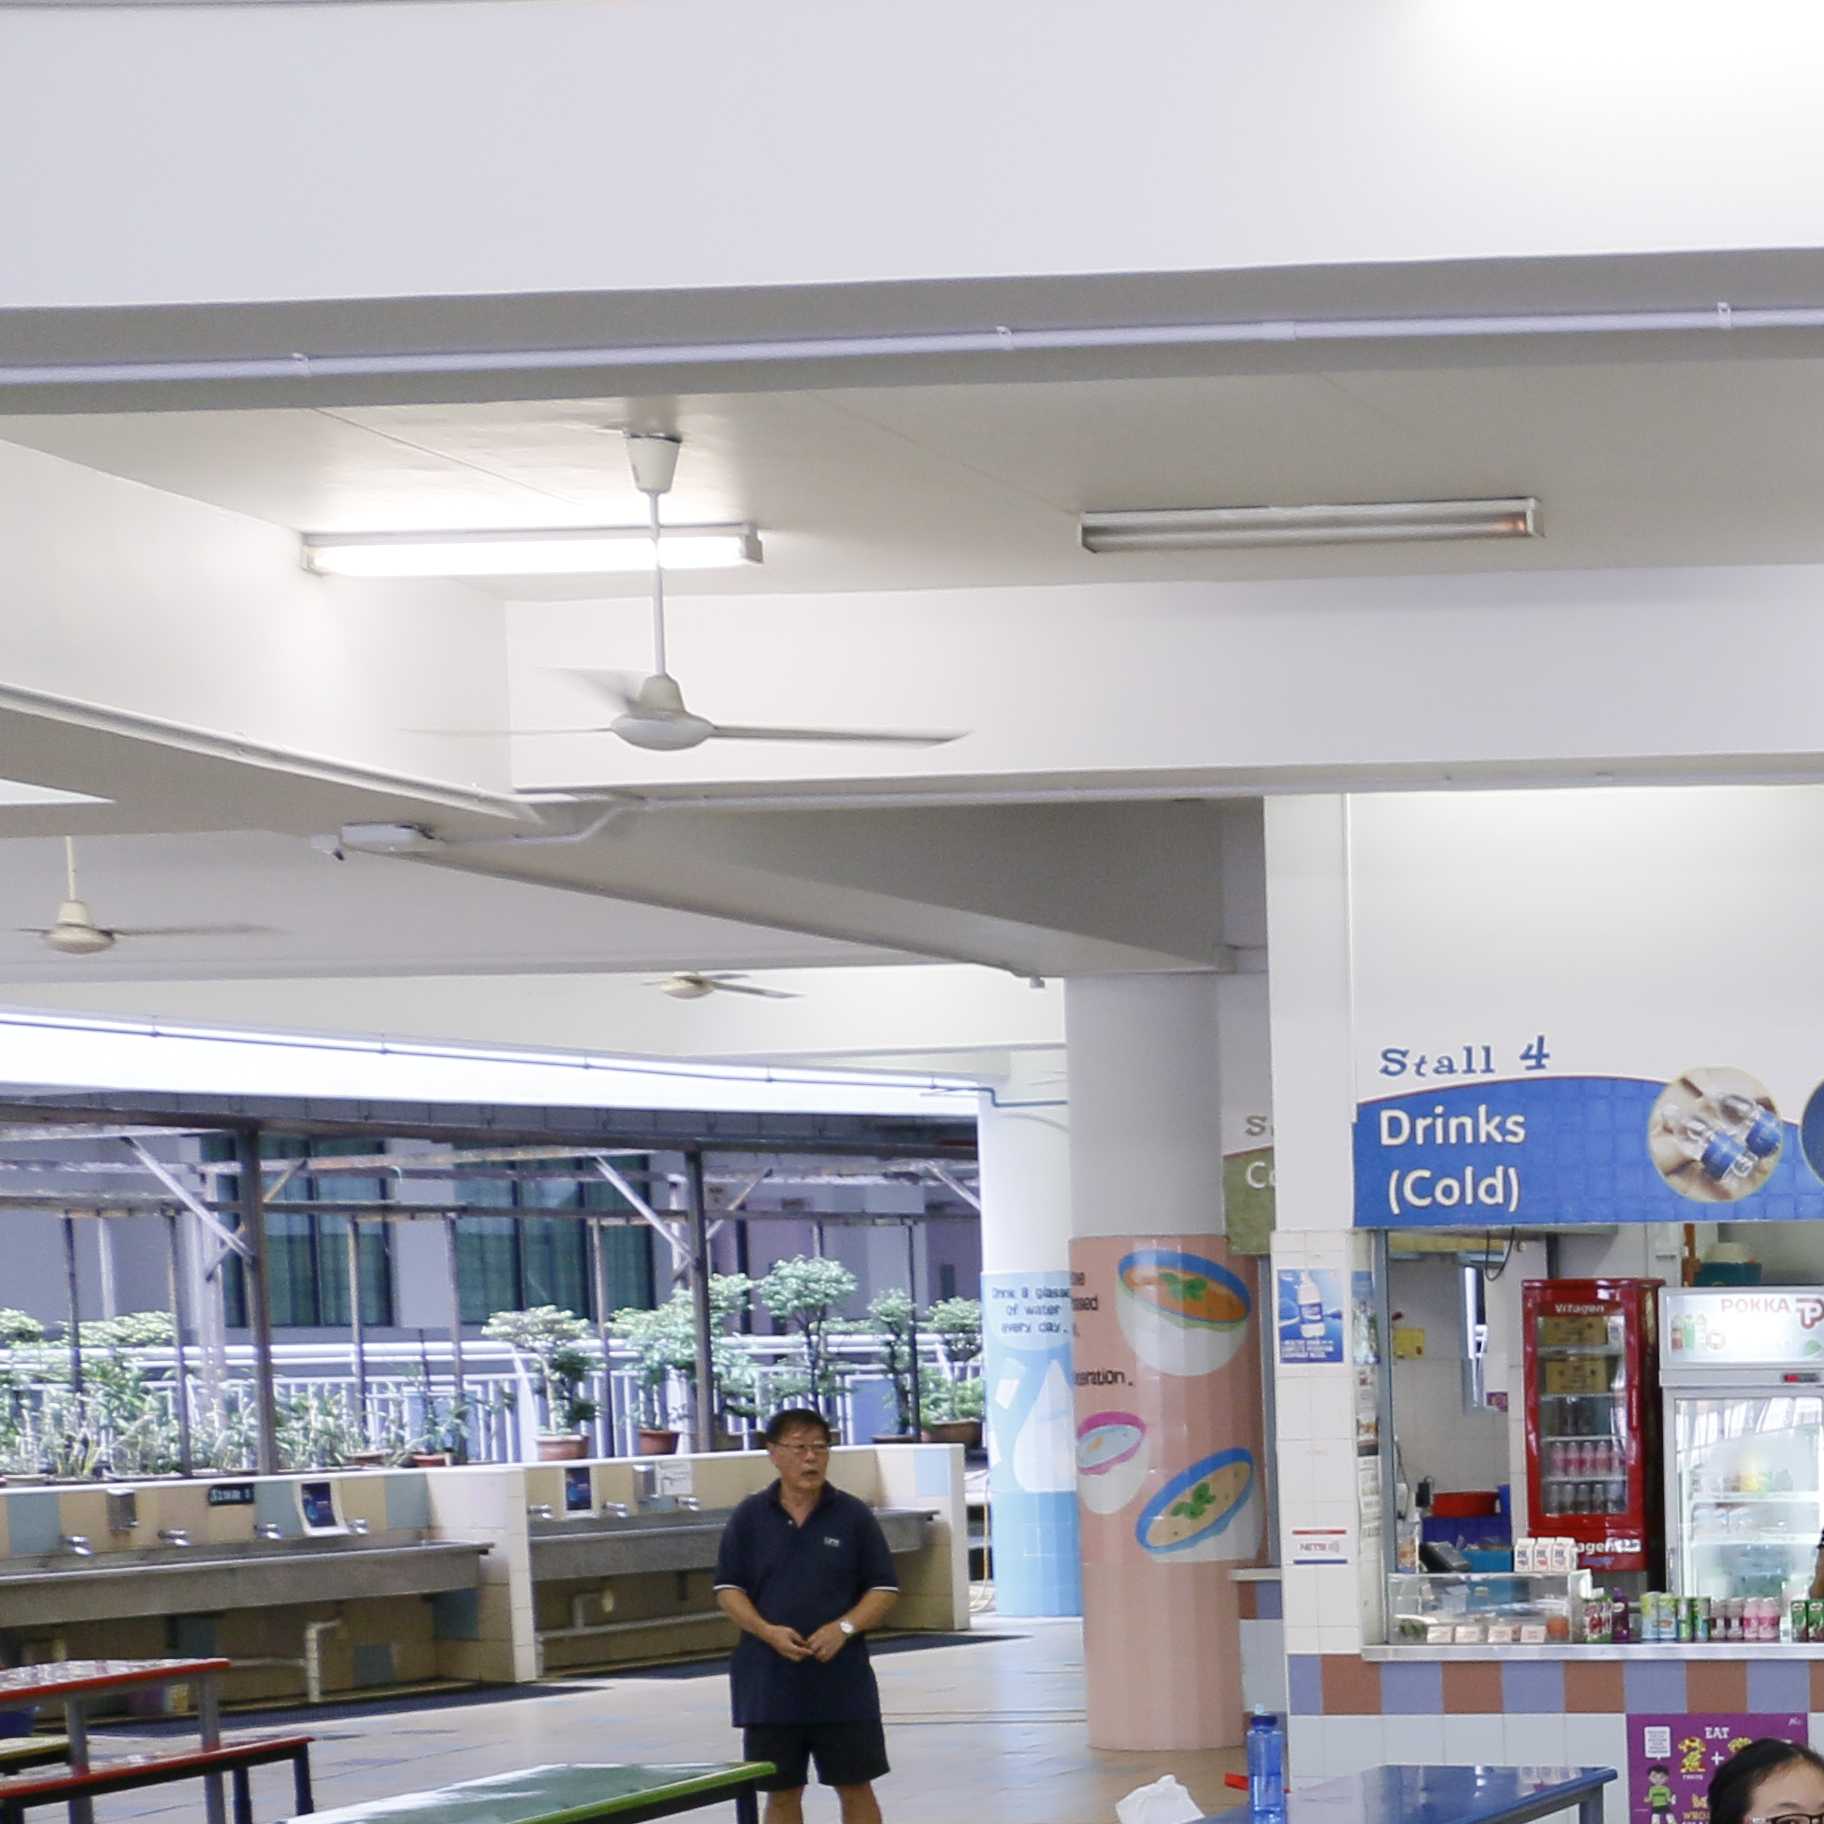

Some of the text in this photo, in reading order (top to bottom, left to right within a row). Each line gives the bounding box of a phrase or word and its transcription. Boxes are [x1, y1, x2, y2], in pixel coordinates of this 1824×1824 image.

[1378, 1034, 1550, 1077] Stall 4
[1379, 1103, 1527, 1146] Drinks
[1388, 1164, 1520, 1215] (Cold)
[1025, 1303, 1062, 1316] water
[1720, 1297, 1791, 1314] POKKA
[1704, 1726, 1730, 1740] EAT
